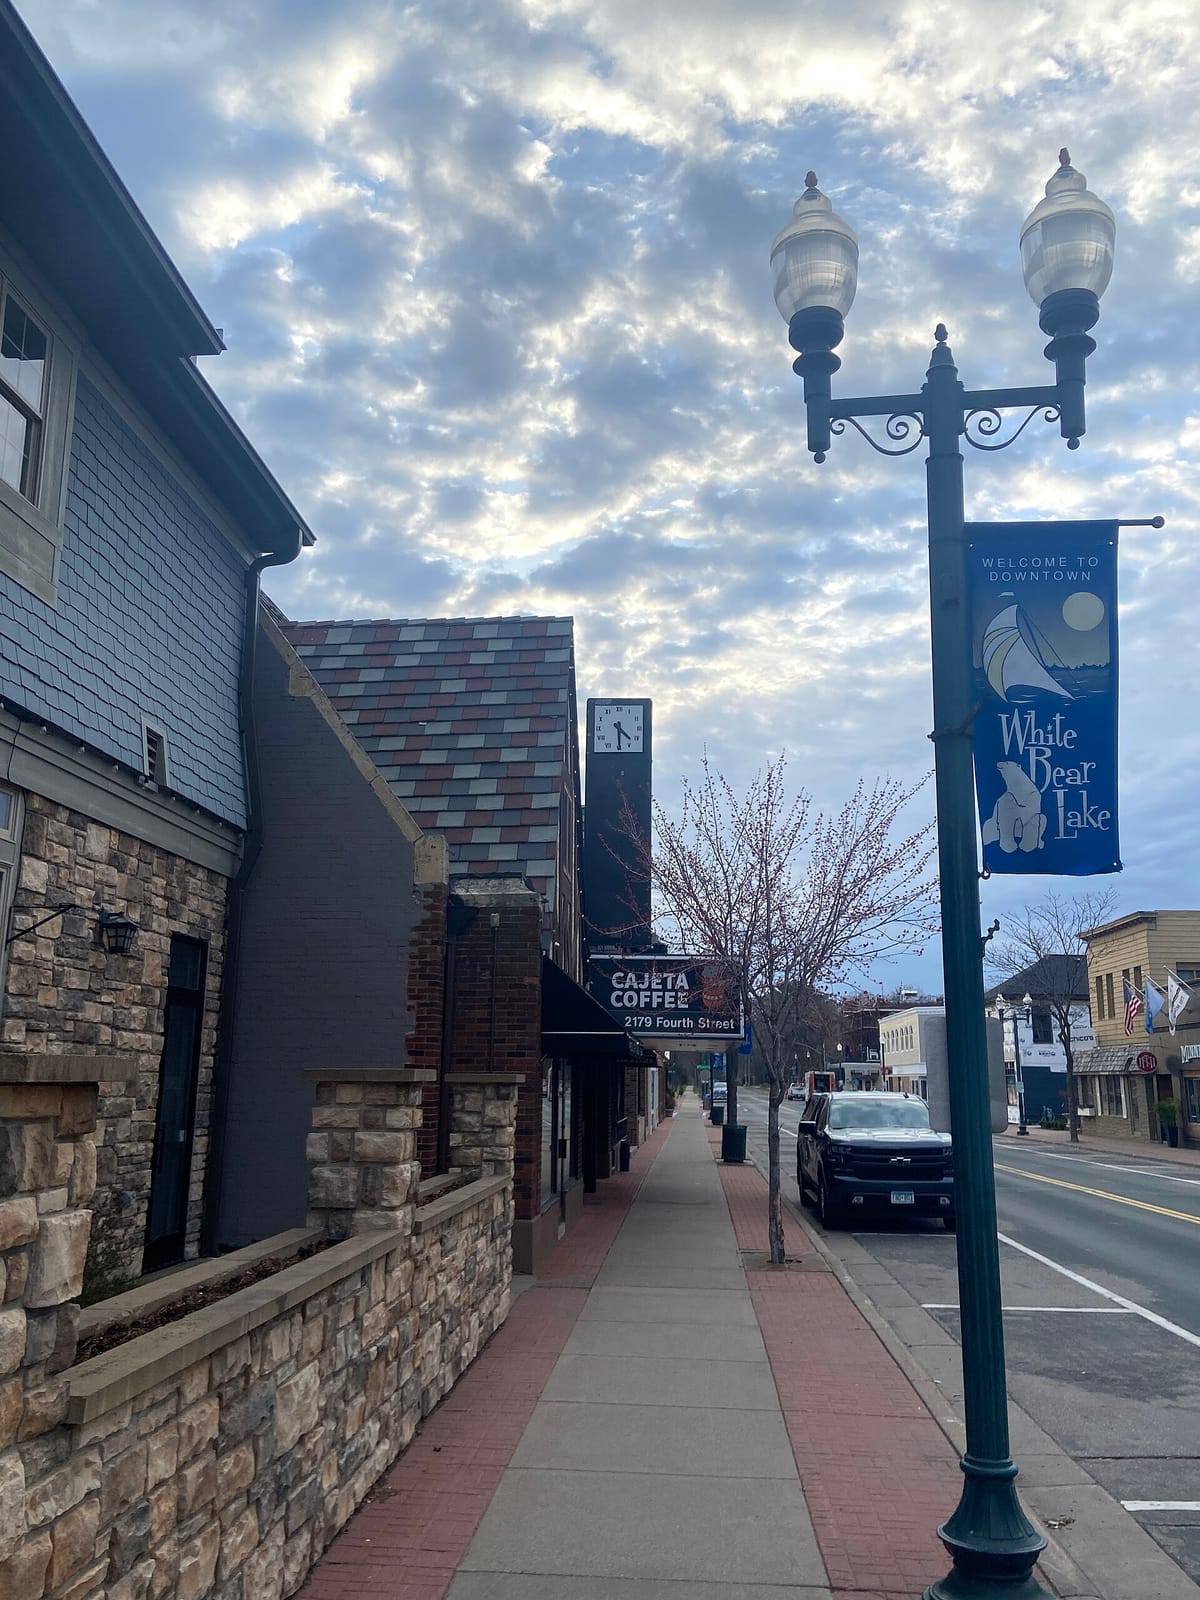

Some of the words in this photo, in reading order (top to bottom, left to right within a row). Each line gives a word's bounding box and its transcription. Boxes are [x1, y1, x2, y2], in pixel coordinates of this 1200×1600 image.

[982, 557, 1067, 568] WELCOME
[1077, 556, 1099, 567] TO
[989, 571, 1091, 582] DOWNTOWN
[998, 708, 1078, 756] White
[1024, 746, 1097, 793] Bear
[1052, 789, 1111, 840] Lake
[611, 972, 689, 989] CAJETA
[610, 991, 689, 1008] COFFEE
[624, 1016, 652, 1028] 2179
[656, 1016, 694, 1029] Fourth
[698, 1017, 735, 1030] Street
